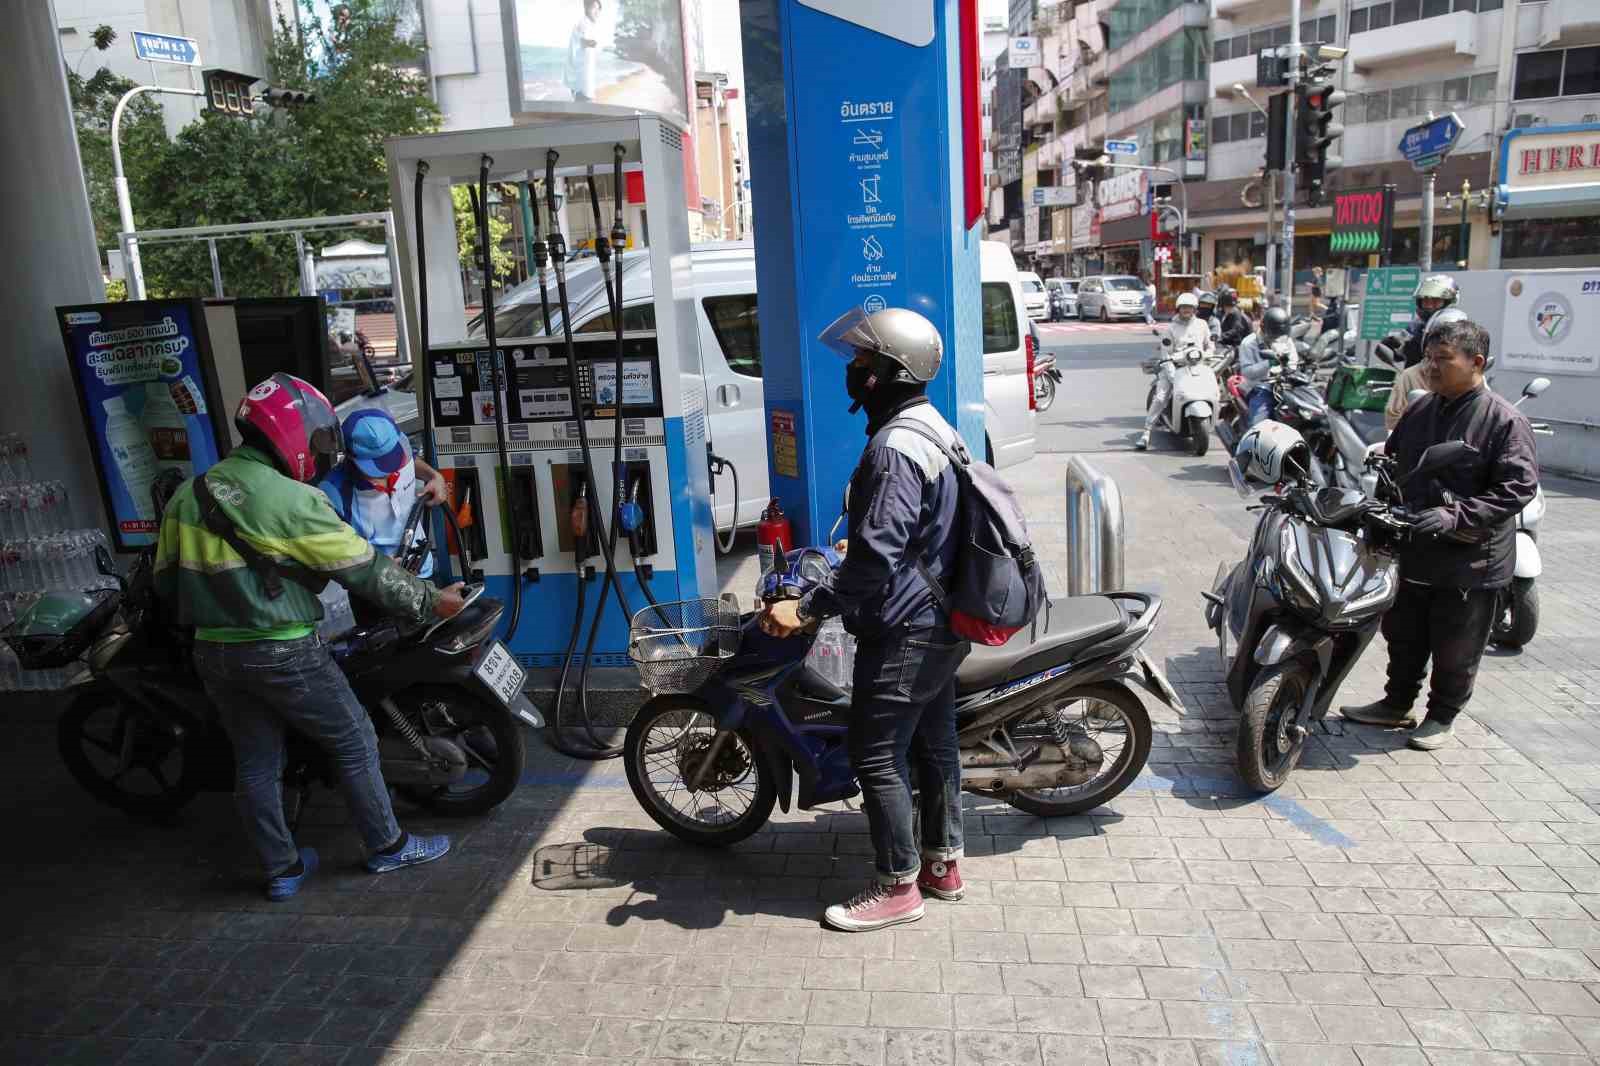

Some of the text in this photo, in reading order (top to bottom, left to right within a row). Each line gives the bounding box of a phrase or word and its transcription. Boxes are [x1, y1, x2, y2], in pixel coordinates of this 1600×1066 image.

[840, 100, 894, 118] อันตราย
[1444, 122, 1452, 140] 4
[848, 149, 889, 164] ห้ามสูบบุหรี่
[865, 205, 877, 214] ปิด
[1334, 191, 1384, 225] TATTOO
[866, 263, 881, 273] ห้าม
